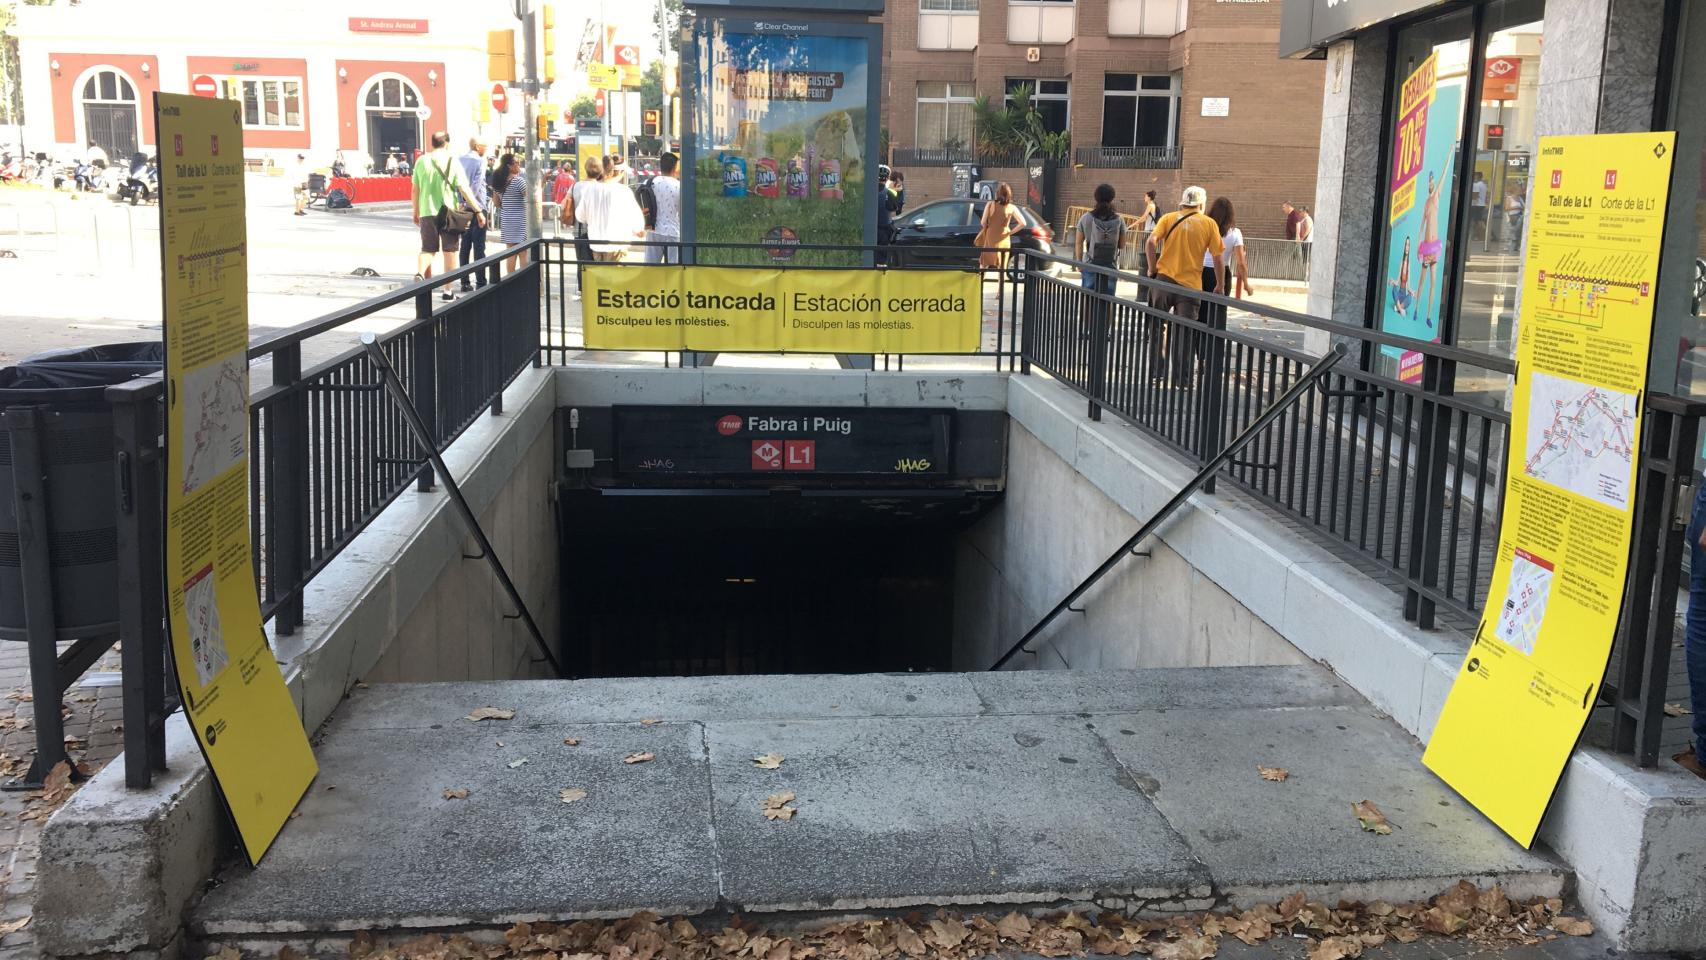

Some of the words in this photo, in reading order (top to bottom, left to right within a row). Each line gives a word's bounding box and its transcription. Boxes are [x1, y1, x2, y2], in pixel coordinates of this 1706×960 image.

[782, 23, 809, 31] Channel
[1403, 58, 1436, 112] REBAIXES
[1552, 173, 1561, 185] L1
[1606, 173, 1616, 185] L1
[1549, 195, 1561, 207] Tall
[1563, 195, 1573, 207] de
[1574, 196, 1582, 207] la
[1583, 197, 1592, 208] L1
[1601, 196, 1623, 209] Corte
[1624, 198, 1635, 210] de
[1636, 198, 1644, 210] la
[1645, 198, 1655, 211] L1
[597, 289, 680, 309] Estació
[686, 291, 776, 311] tancada
[794, 293, 881, 312] Estación
[888, 294, 966, 313] cerrada
[597, 316, 652, 328] Disculpeu
[655, 316, 672, 326] les
[675, 316, 730, 327] molèsties.
[792, 319, 843, 331] Disculpen
[846, 319, 860, 329] las
[863, 320, 914, 330] molestias.
[722, 421, 741, 429] TMB
[748, 416, 798, 431] Fabra
[803, 417, 808, 431] i
[813, 417, 852, 435] Puig
[789, 446, 810, 464] L1
